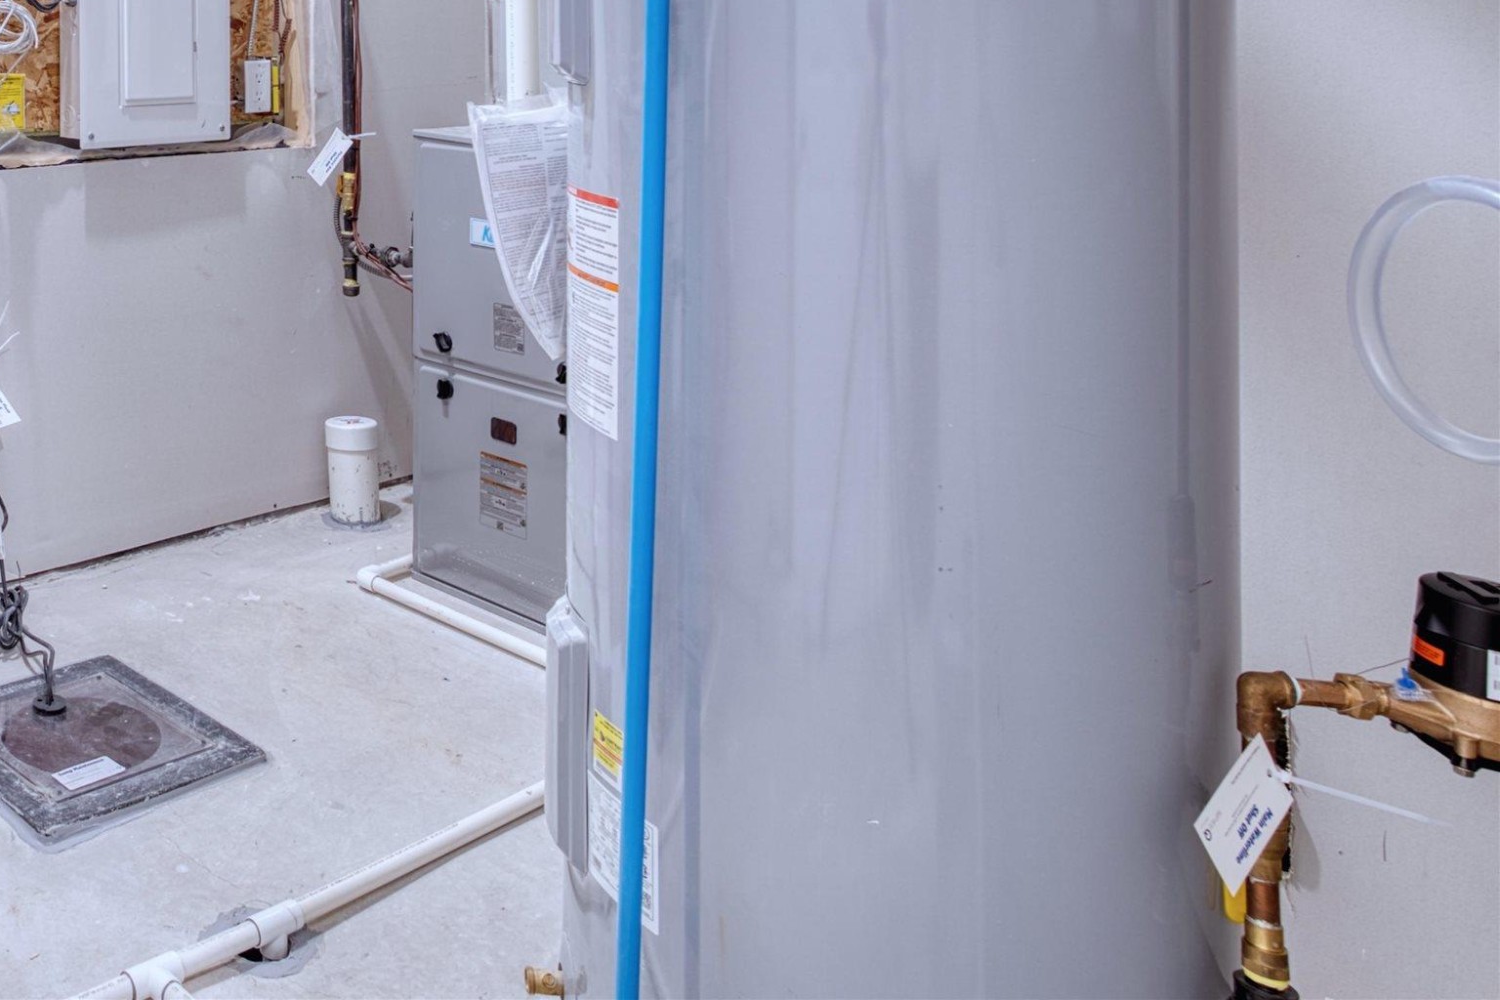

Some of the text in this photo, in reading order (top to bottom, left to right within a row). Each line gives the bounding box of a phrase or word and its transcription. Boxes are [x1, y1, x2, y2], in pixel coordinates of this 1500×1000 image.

[1236, 805, 1260, 839] Shut Off
[1236, 807, 1274, 864] Main Waterline
